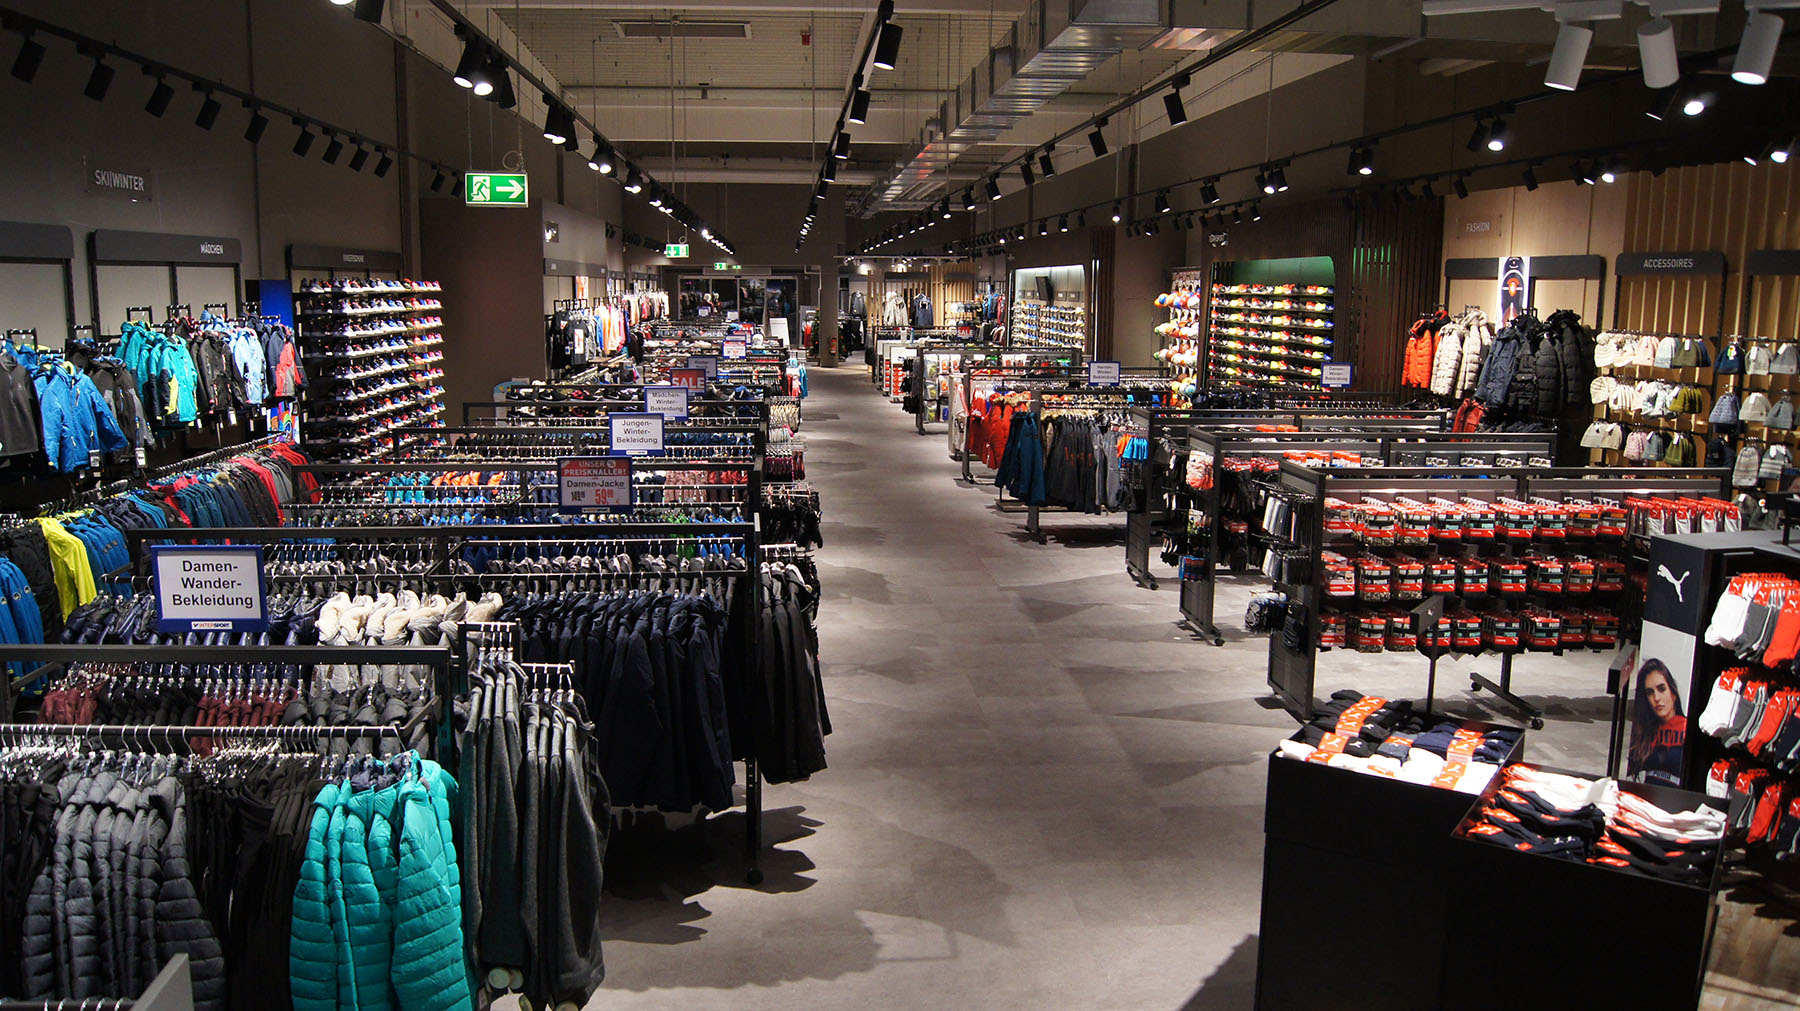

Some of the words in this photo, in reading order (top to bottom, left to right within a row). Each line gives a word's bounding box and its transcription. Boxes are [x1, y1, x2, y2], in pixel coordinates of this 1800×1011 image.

[1466, 221, 1490, 232] FASHION
[200, 242, 224, 255] MÄDCHEN
[1643, 258, 1694, 268] ACCESSOIRES
[672, 377, 705, 388] SALE
[650, 405, 684, 413] Bekleidung
[616, 436, 658, 445] Bekleidung
[579, 460, 605, 468] UNSER
[564, 468, 626, 476] PREISKNALLER!
[567, 480, 625, 488] Damen-Jacke
[182, 560, 239, 572] Damen-
[181, 577, 242, 589] Wander-
[172, 594, 254, 609] Bekleidung
